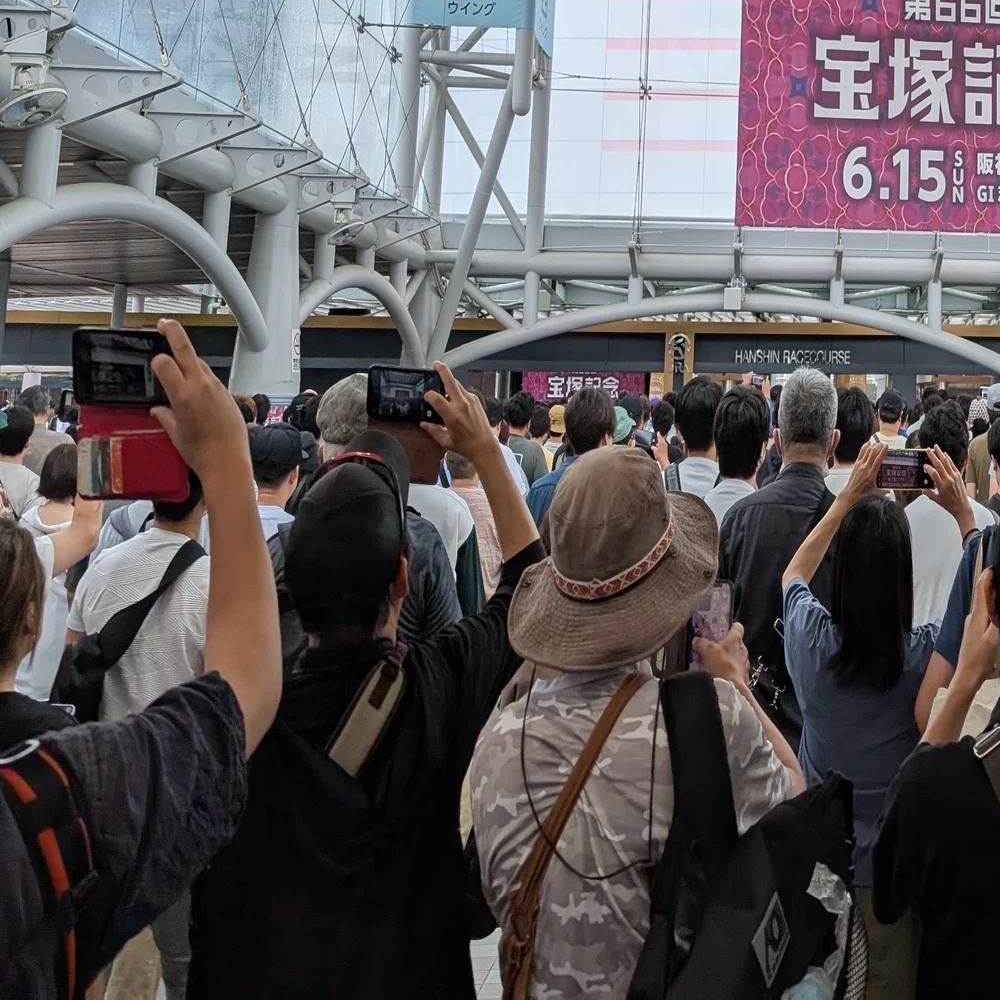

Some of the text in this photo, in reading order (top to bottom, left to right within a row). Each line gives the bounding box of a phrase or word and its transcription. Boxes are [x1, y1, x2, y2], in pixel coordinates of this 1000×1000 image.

[448, 0, 497, 16] ウイング
[842, 146, 947, 202] 6.15
[952, 150, 964, 203] SUN
[735, 349, 851, 364] HANSHIN RACECOURSE
